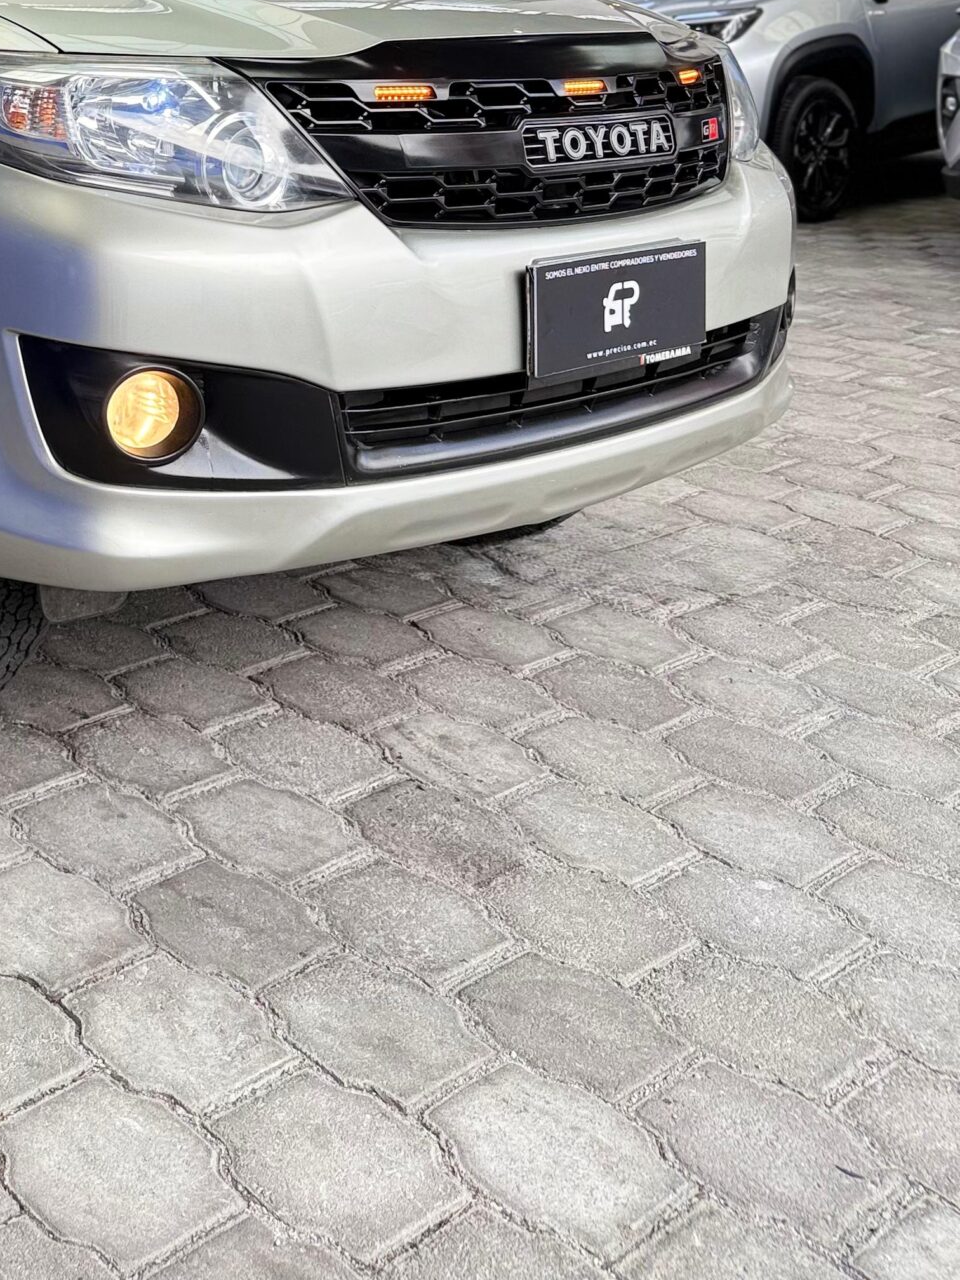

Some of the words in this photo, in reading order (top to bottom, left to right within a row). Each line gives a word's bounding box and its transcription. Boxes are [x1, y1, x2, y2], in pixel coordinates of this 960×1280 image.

[537, 120, 670, 163] TOYOTA
[545, 269, 566, 280] SOMOS
[566, 268, 574, 276] EL
[574, 265, 590, 275] NEXO
[590, 261, 610, 272] ENTRE
[609, 254, 654, 269] COMPRADORES
[659, 249, 697, 262] VENDEDORES
[587, 340, 657, 358] www.preciso.com.ec
